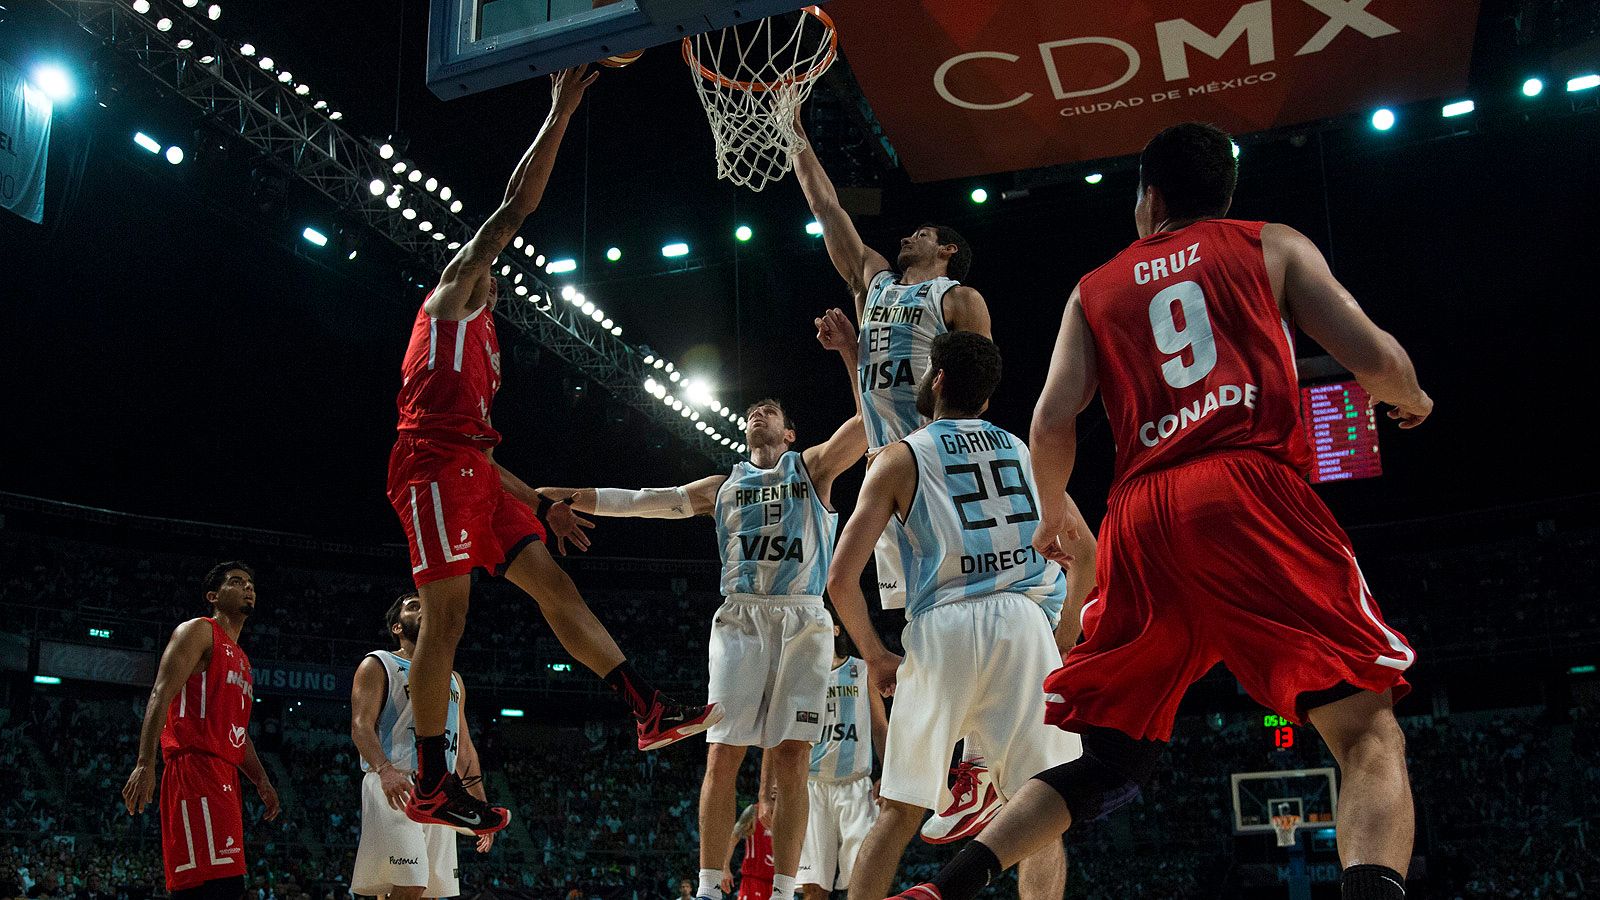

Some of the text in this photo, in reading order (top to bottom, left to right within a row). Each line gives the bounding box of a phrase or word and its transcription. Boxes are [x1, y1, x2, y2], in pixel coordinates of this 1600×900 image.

[933, 0, 1400, 110] CDMX
[1059, 71, 1277, 117] CIUDAD DE MÉXICO
[1134, 243, 1200, 285] CRUZ
[869, 327, 891, 353] 83
[1149, 280, 1217, 389] 9
[858, 358, 915, 394] VISA
[1139, 382, 1259, 448] CONADE
[940, 430, 1012, 455] GARINO
[945, 459, 1039, 530] 29
[764, 504, 782, 526] 13
[737, 535, 804, 563] VISA
[960, 545, 1052, 575] DIRECT
[252, 668, 336, 691] MSUNG
[827, 703, 837, 718] 4
[1275, 727, 1294, 748] 13
[389, 856, 418, 865] Personal
